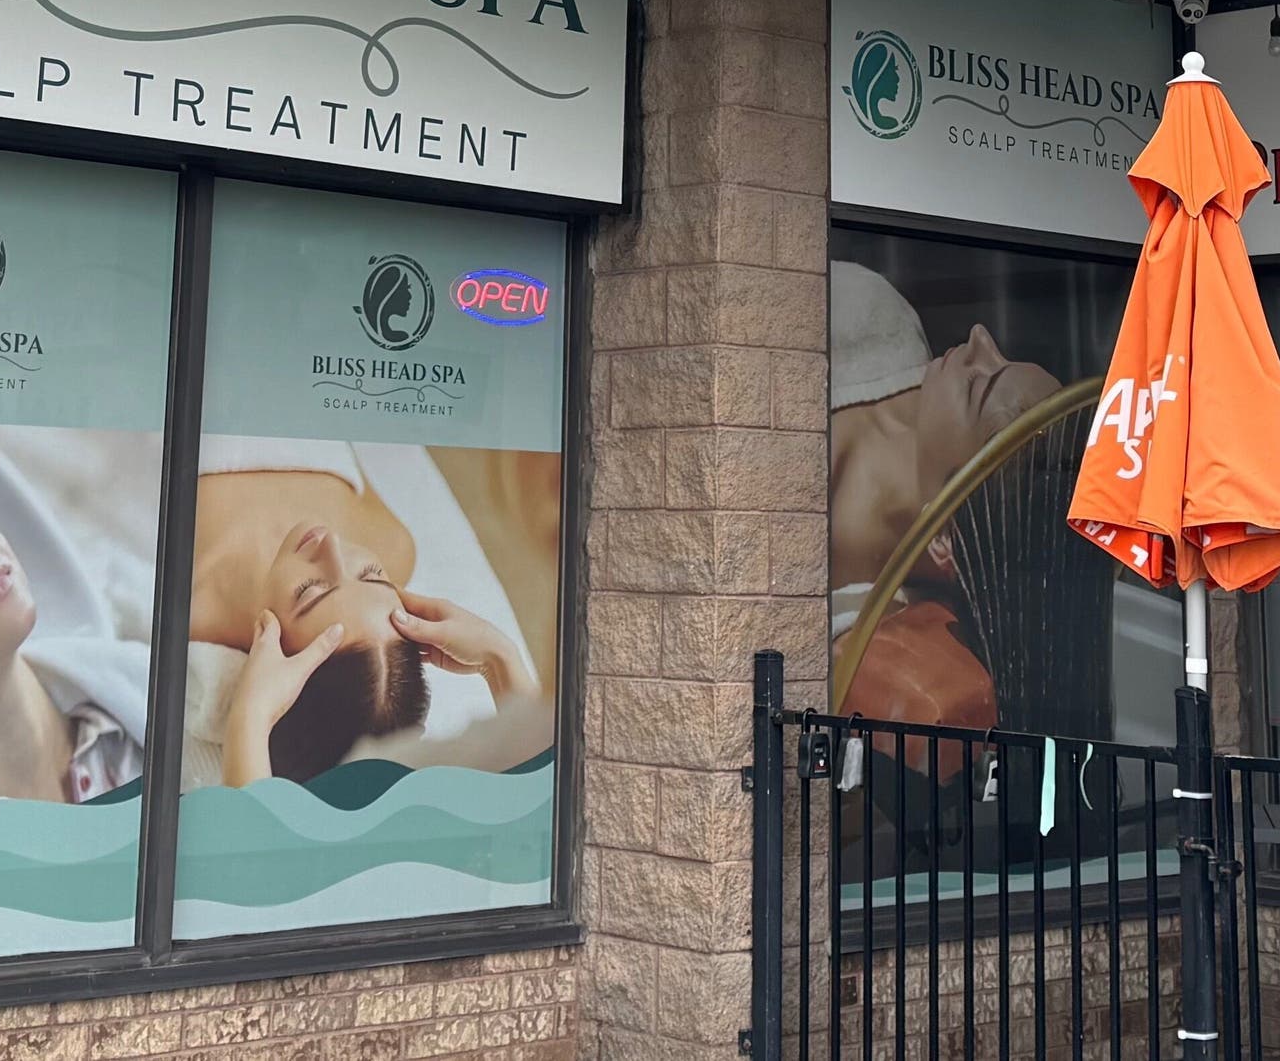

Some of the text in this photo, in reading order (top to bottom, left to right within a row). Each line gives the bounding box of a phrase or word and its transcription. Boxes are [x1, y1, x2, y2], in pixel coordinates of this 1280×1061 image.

[927, 44, 1160, 121] BLISS HEAD SPA
[124, 70, 528, 172] TREATMENT
[948, 126, 1132, 172] SCALP TREATMEN
[457, 279, 548, 315] OPEN
[0, 332, 43, 355] SPA
[312, 355, 466, 385] BLISS HEAD SPA
[323, 398, 454, 417] SCALP TREATMENT
